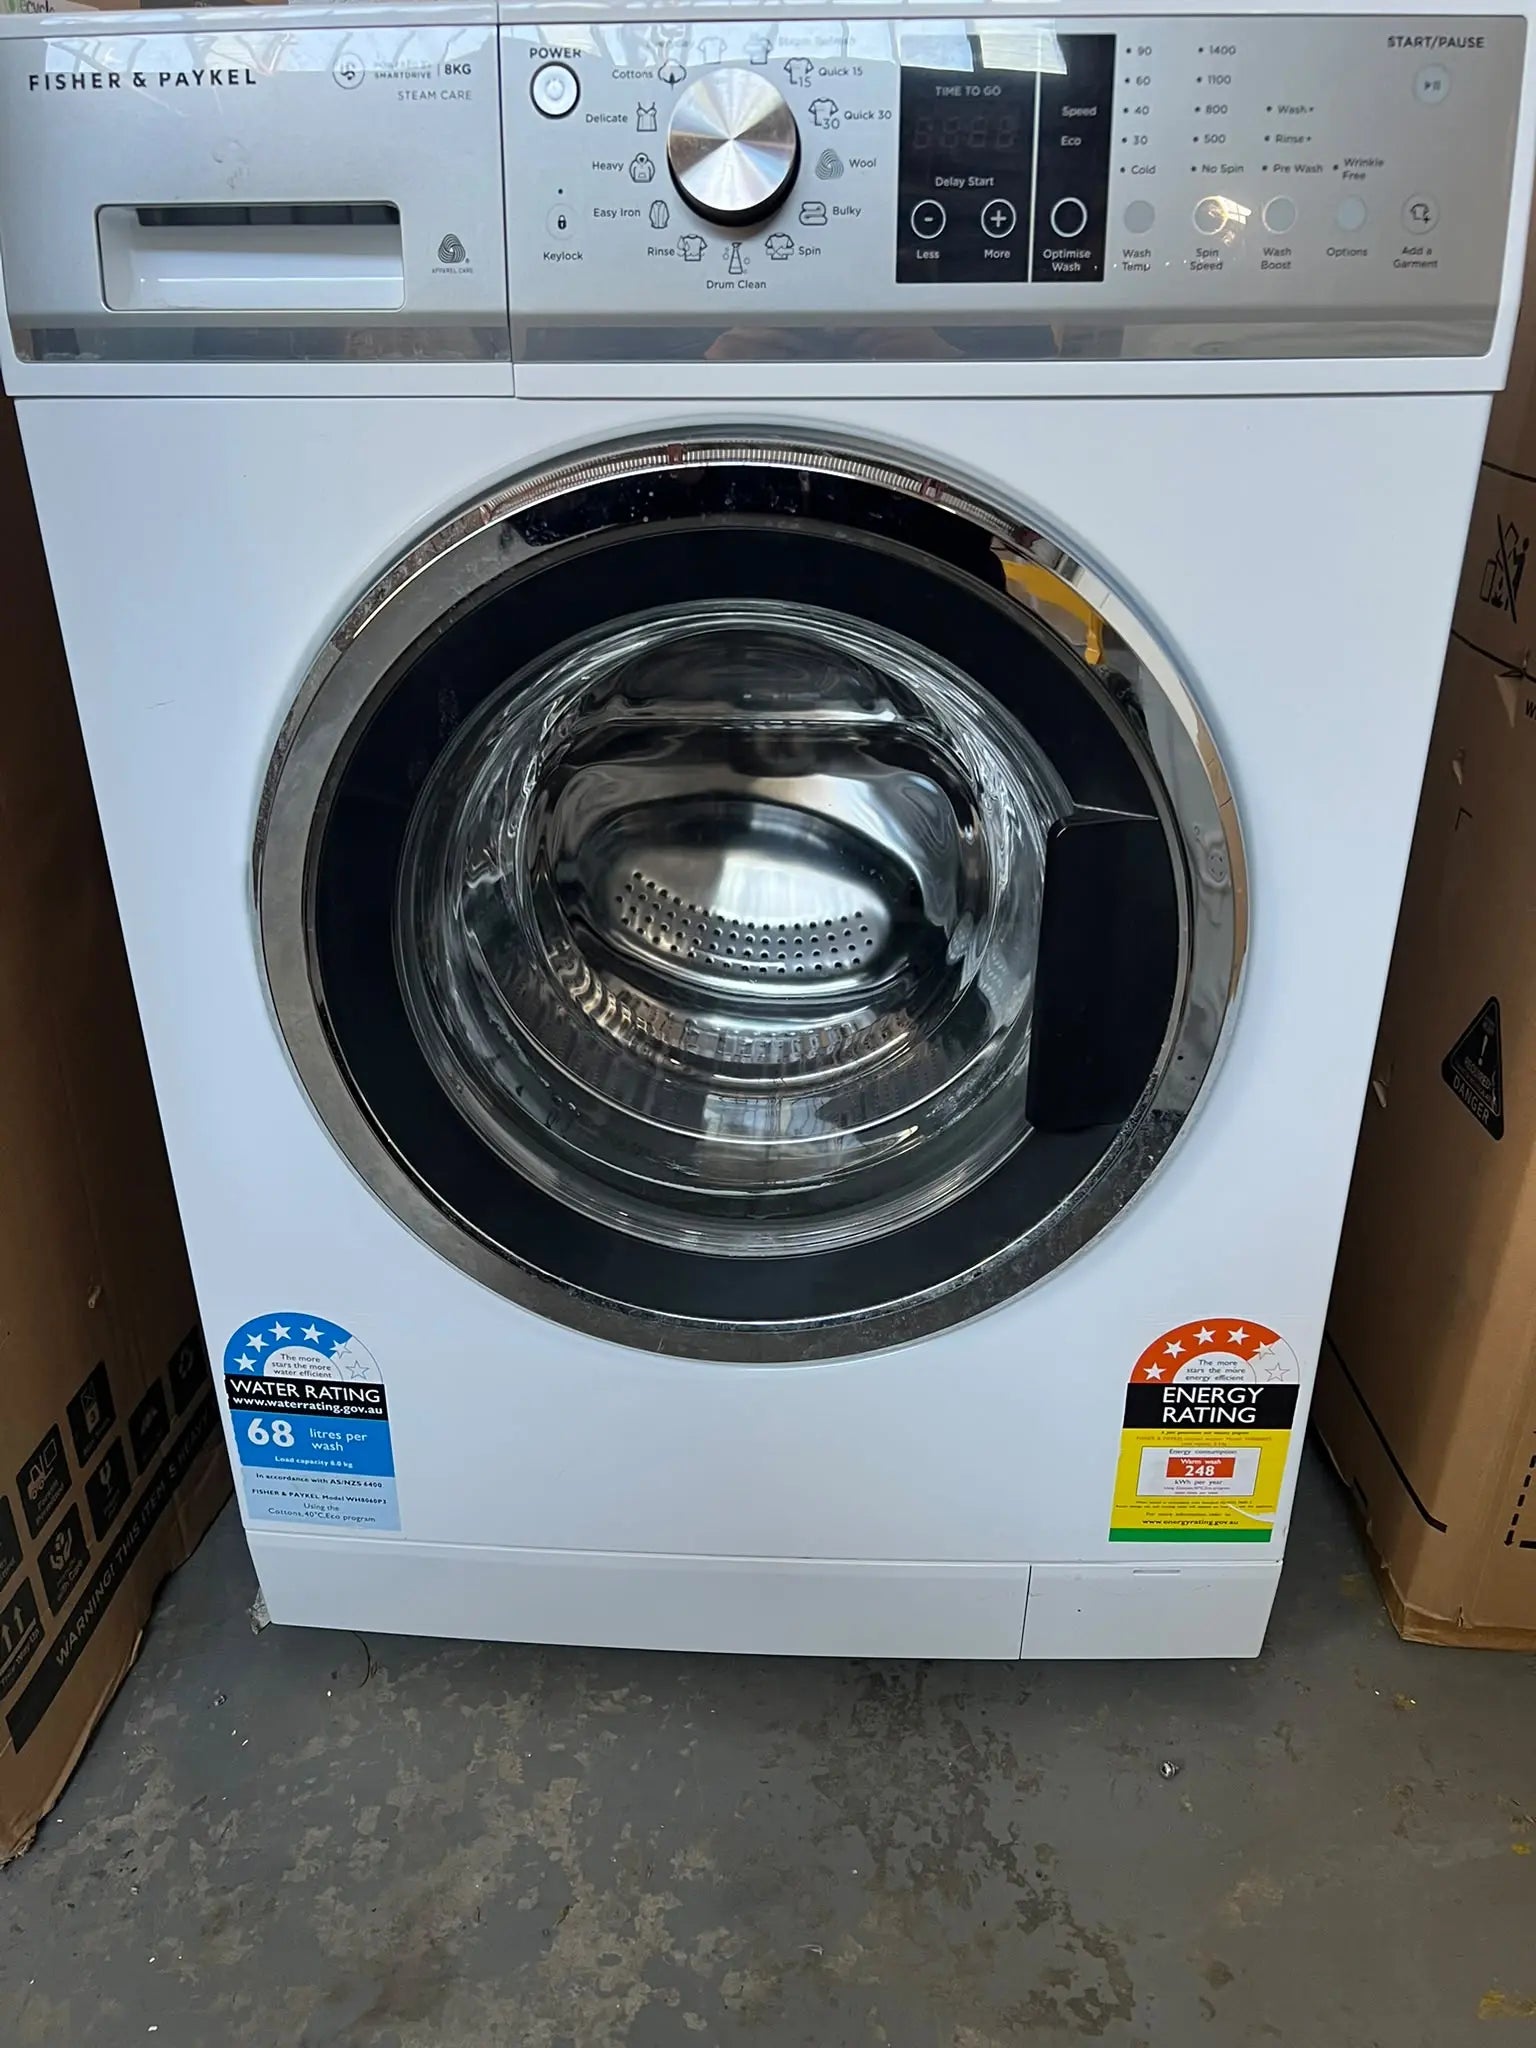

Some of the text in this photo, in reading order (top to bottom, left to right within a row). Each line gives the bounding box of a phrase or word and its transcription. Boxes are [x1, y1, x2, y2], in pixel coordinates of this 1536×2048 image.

[1387, 35, 1486, 50] START/PAUSE
[529, 47, 582, 60] POWER
[1137, 46, 1153, 56] 90
[1208, 45, 1237, 56] 1400
[444, 63, 472, 75] 8KG
[612, 67, 654, 81] Cottons
[818, 66, 863, 77] Quick 15
[29, 68, 258, 91] FISHER & PAYKEL
[799, 77, 812, 88] 15
[1136, 76, 1152, 86] 60
[1207, 75, 1232, 85] 1100
[398, 90, 473, 100] STEAM CARE
[935, 85, 1002, 97] TIME TO GO
[1061, 105, 1098, 118] Speed
[1134, 105, 1150, 115] 40
[1205, 104, 1229, 115] 800
[585, 112, 628, 124] Delicate
[844, 110, 893, 122] Quick 30
[823, 117, 840, 130] 30
[1060, 135, 1082, 147] Eco
[1133, 135, 1148, 145] 30
[1203, 133, 1227, 145] 500
[592, 160, 624, 173] Heavy
[848, 158, 877, 169] Wool
[1343, 157, 1385, 168] Wrinkle
[1130, 164, 1156, 176] Cold
[1202, 163, 1245, 176] No Spin
[1273, 163, 1324, 175] Pre Wash
[1342, 170, 1367, 181] Free
[935, 176, 995, 189] Delay Start
[593, 207, 641, 220] Easy Iron
[832, 205, 862, 218] Bulky
[543, 250, 584, 262] Keylock
[647, 245, 676, 257] Rinse
[798, 245, 822, 258] Spin
[916, 249, 940, 260] Less
[984, 249, 1011, 259] More
[1043, 249, 1092, 261] Optimise
[1122, 249, 1151, 259] Wash
[1195, 247, 1219, 260] Spin
[1263, 247, 1292, 258] Wash
[1326, 246, 1368, 260] Options
[1402, 245, 1433, 257] Add a
[1052, 262, 1081, 272] Wash
[1122, 261, 1151, 273] Temp
[1189, 260, 1223, 273] Speed
[1260, 260, 1292, 271] Boost
[1392, 258, 1438, 271] Garment
[706, 278, 767, 290] Drum Clean
[1453, 1075, 1490, 1124] DANGER
[280, 1353, 297, 1362] The
[272, 1361, 292, 1369] stars
[294, 1362, 308, 1370] the
[299, 1370, 332, 1378] efficient
[230, 1379, 381, 1403] WATER RATING
[1162, 1387, 1264, 1404] ENERGY
[232, 1397, 383, 1415] www.waterrating.gov.au
[1162, 1407, 1257, 1423] RATING
[247, 1417, 295, 1448] 68
[309, 1428, 368, 1443] litres per
[311, 1442, 344, 1452] wash
[1185, 1465, 1215, 1477] 248
[289, 1491, 320, 1499] PAYKEL
[304, 1502, 325, 1511] Using
[343, 1514, 376, 1522] program
[55, 1563, 117, 1667] WARNING!
[114, 1521, 141, 1565] THIS
